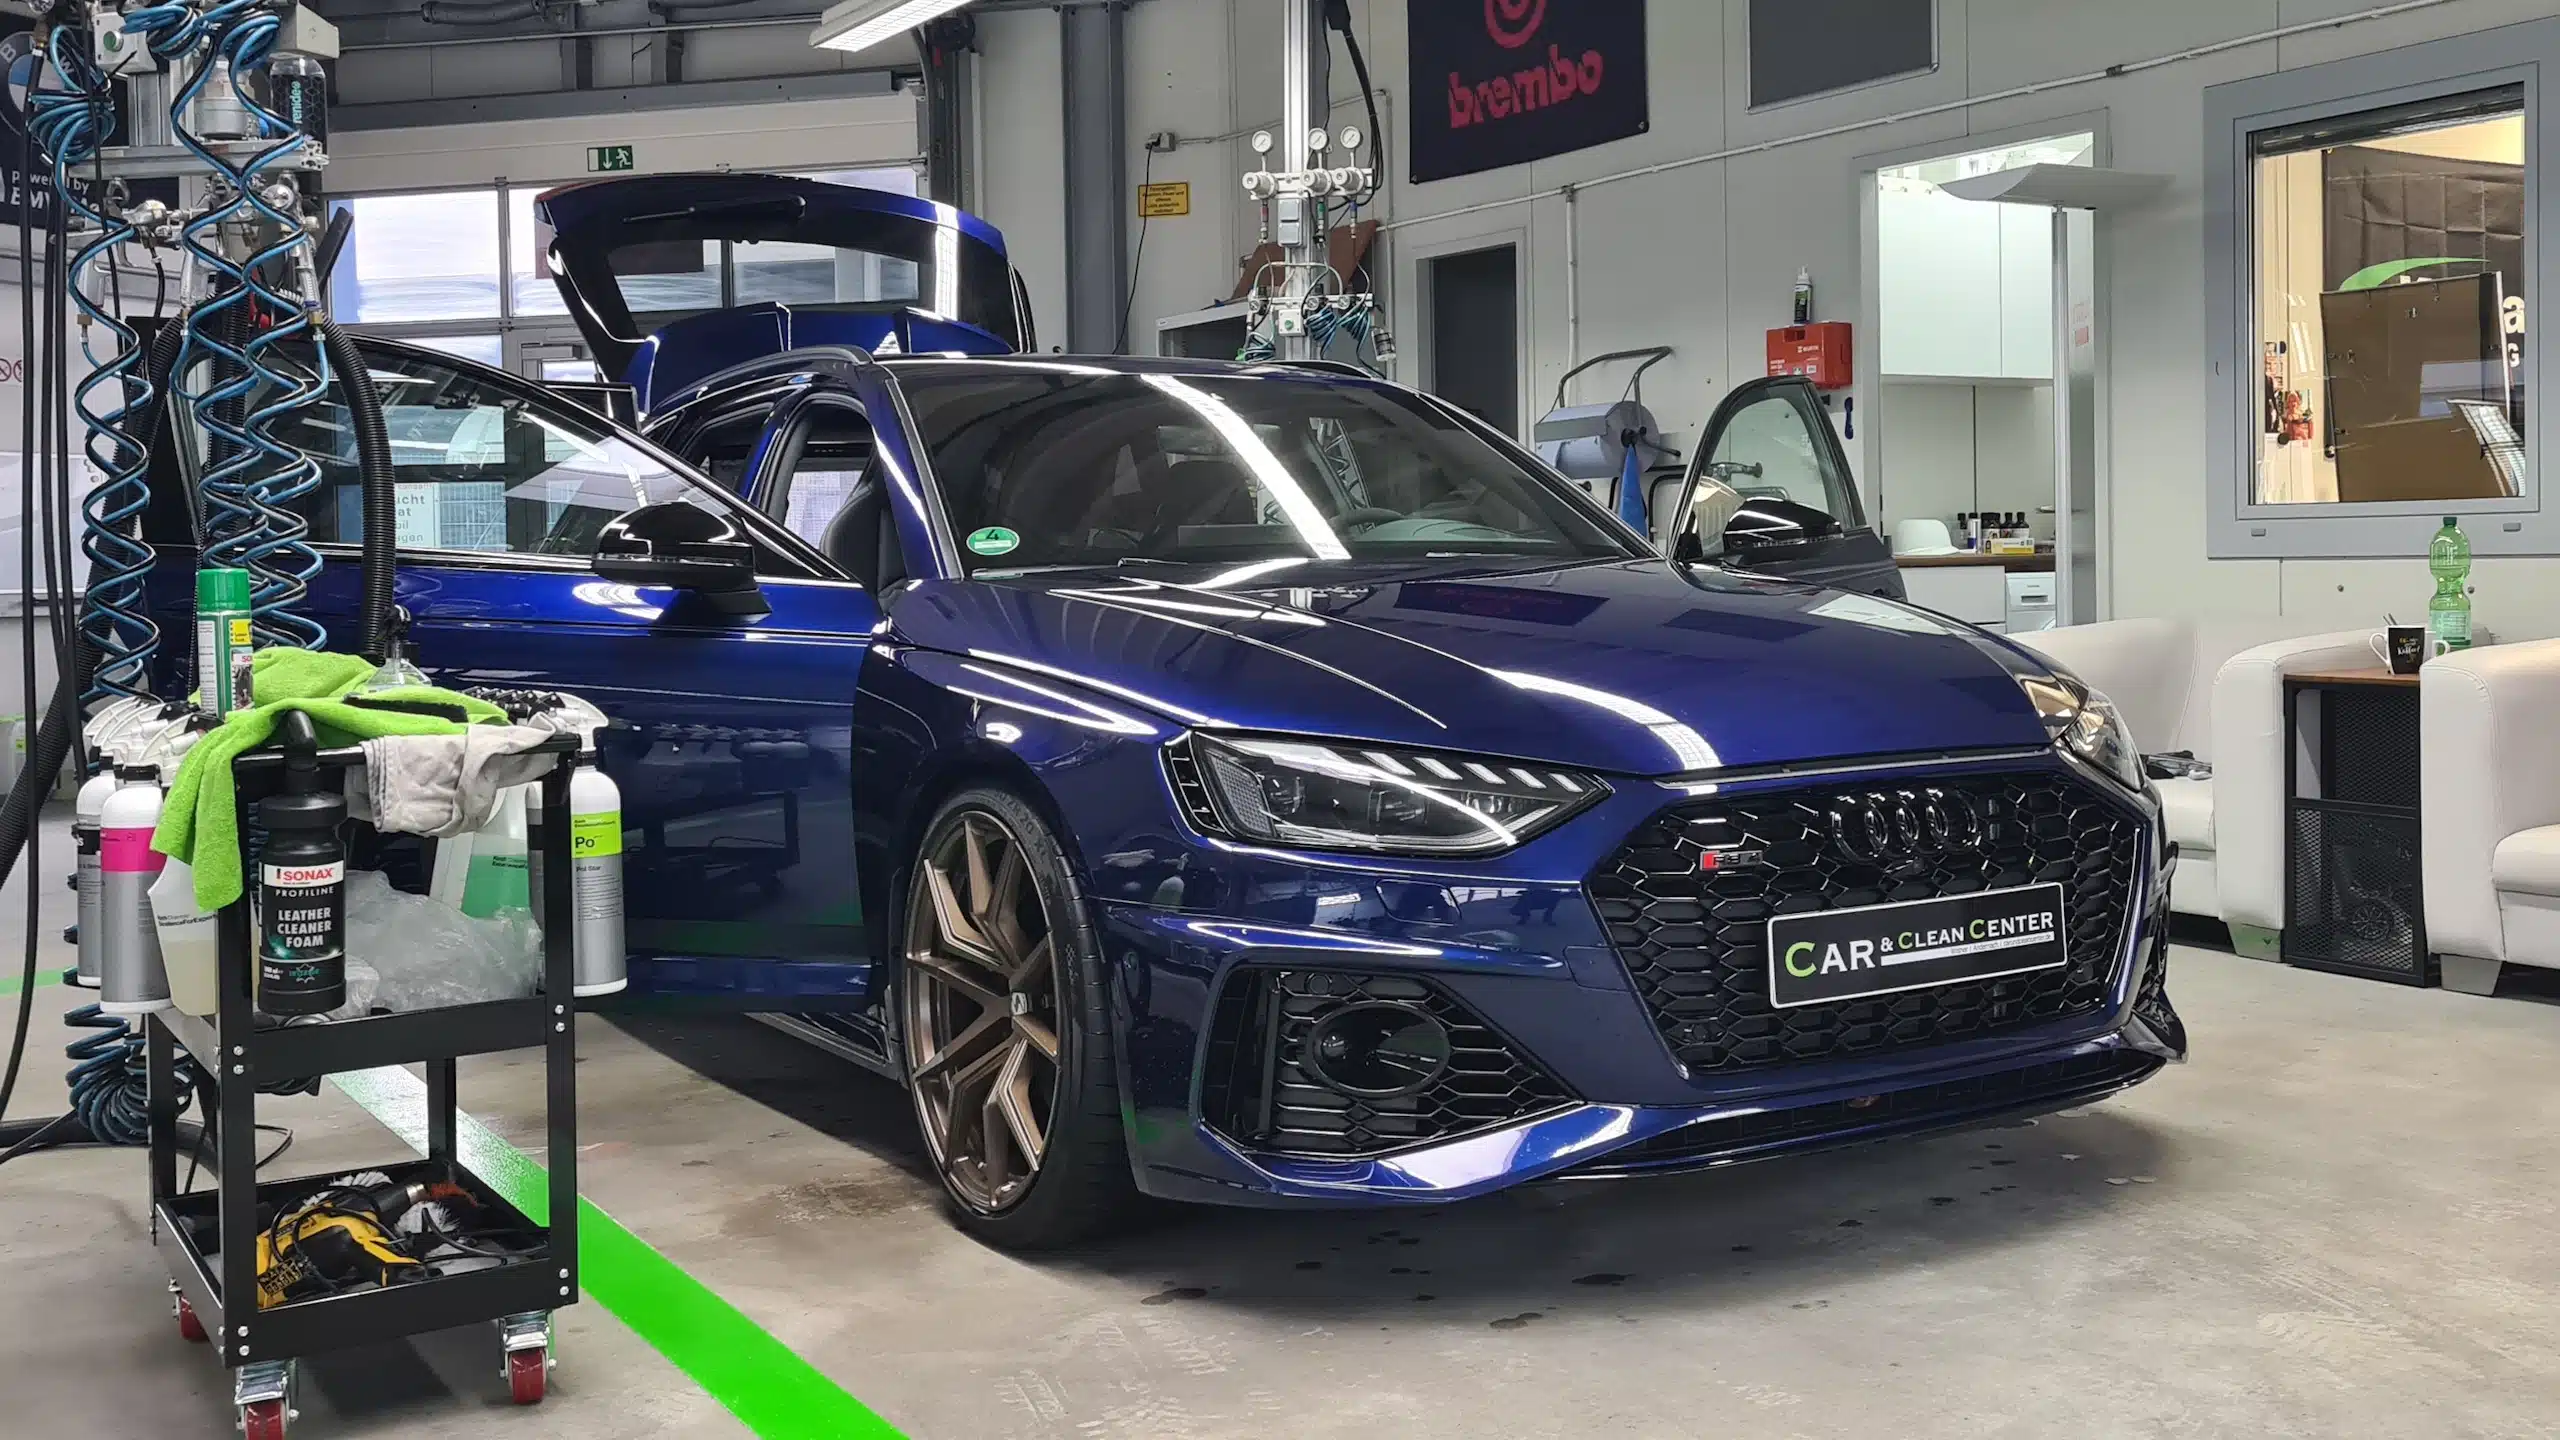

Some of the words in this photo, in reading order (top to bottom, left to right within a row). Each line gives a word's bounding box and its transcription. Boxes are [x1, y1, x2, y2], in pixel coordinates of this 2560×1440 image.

[1449, 43, 1603, 128] brembo
[74, 177, 90, 195] by
[986, 529, 999, 540] 4
[575, 836, 595, 848] Po
[283, 868, 334, 881] SONAX
[275, 886, 334, 898] PROFILINE
[278, 907, 332, 921] LEATHER
[277, 920, 332, 935] CLEANER
[286, 935, 324, 948] FOAM
[1785, 939, 1876, 978] CAR
[1880, 937, 1893, 952] &
[1898, 926, 1965, 950] CLEAN
[1969, 911, 2054, 939] CENTER
